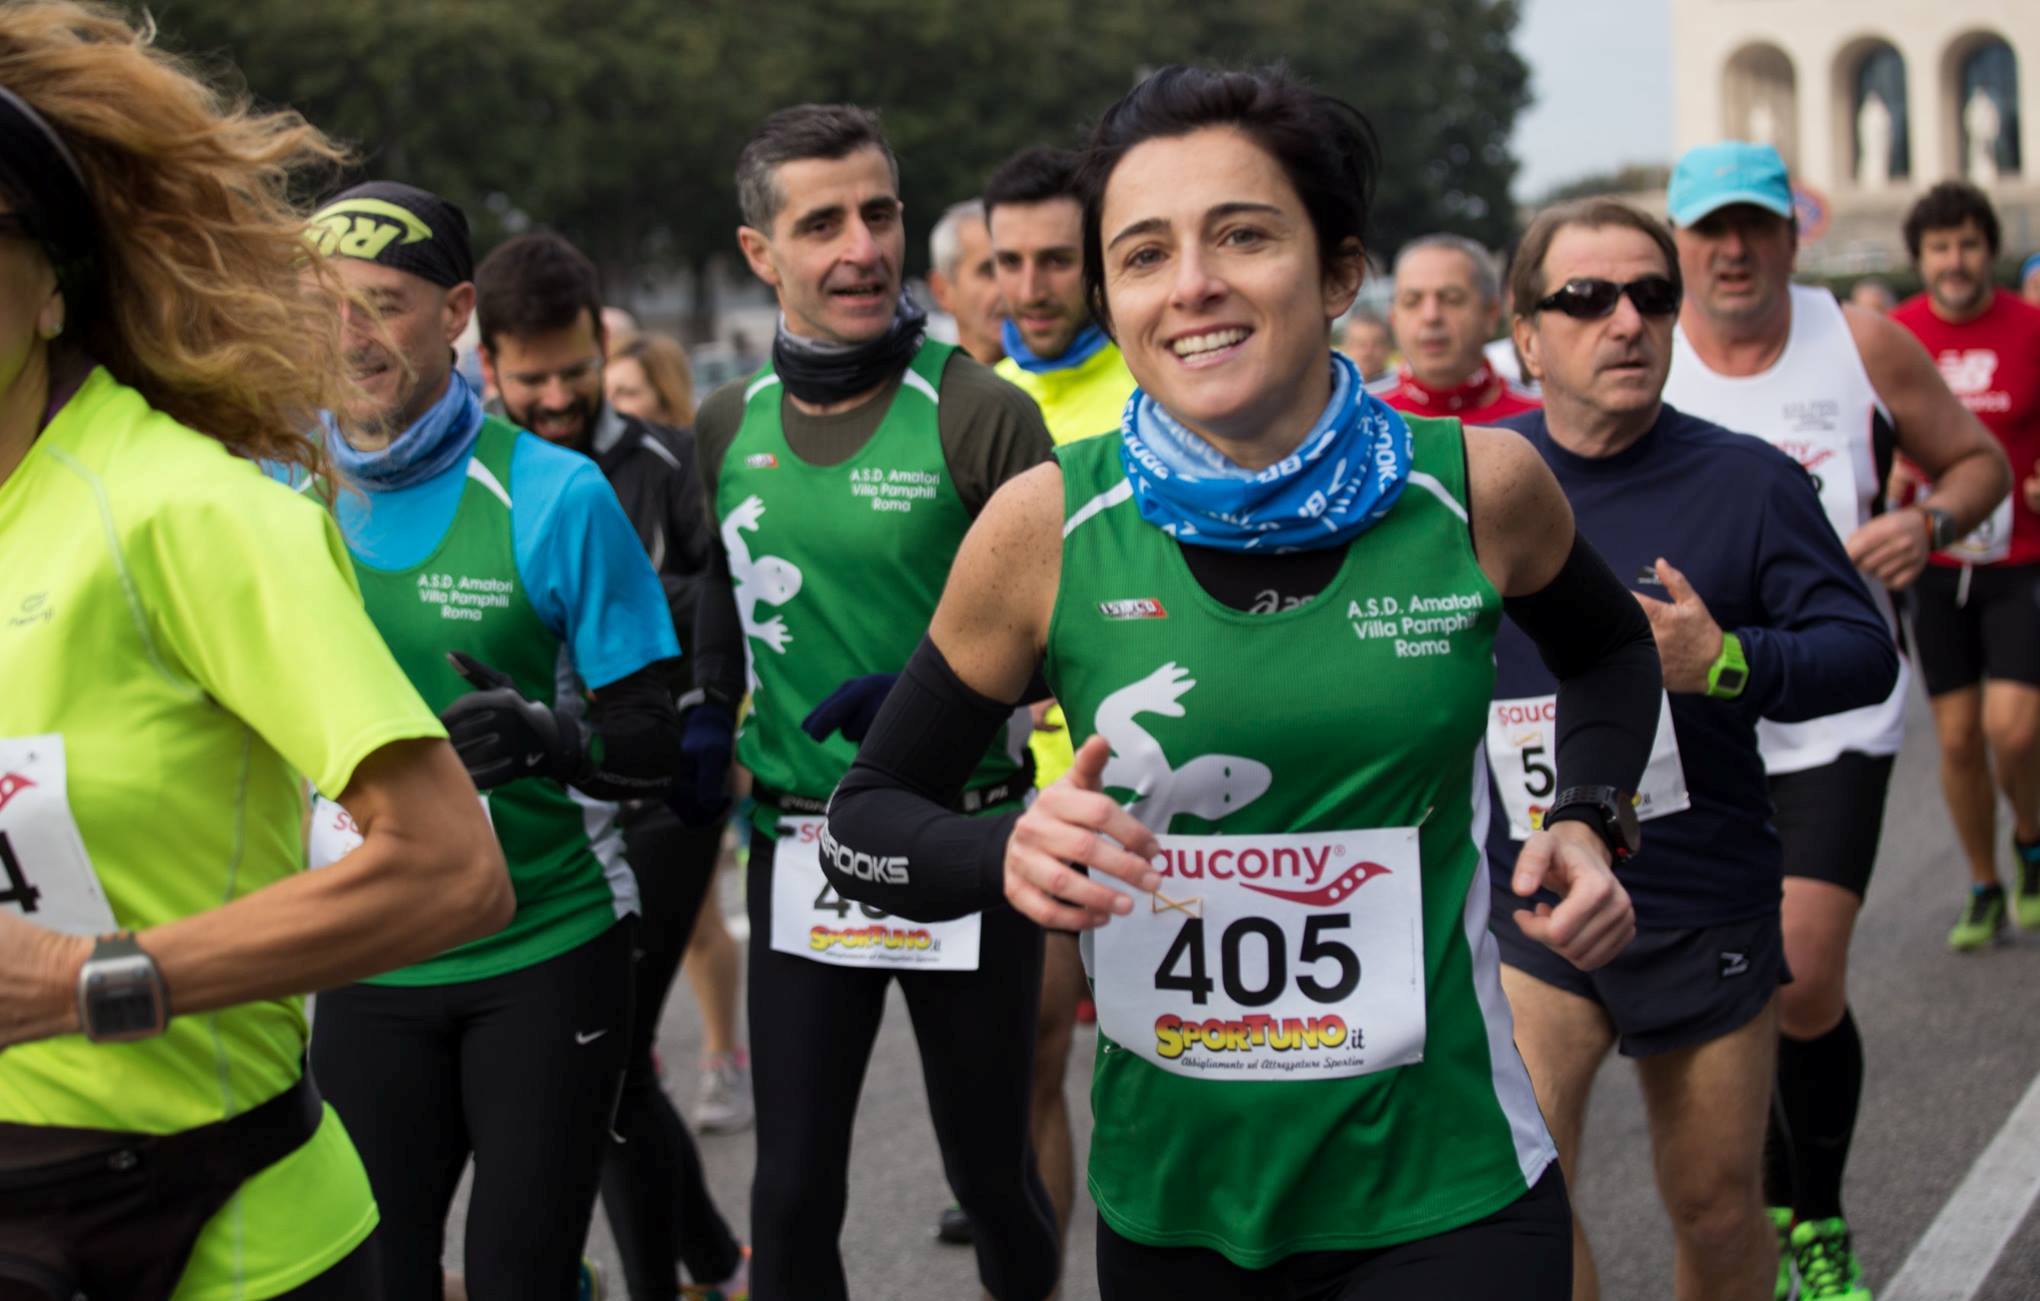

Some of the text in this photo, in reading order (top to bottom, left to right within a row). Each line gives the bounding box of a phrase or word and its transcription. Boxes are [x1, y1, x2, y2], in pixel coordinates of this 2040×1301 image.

[888, 470, 940, 485] Amatori
[851, 484, 878, 496] Villa
[872, 498, 911, 512] Roma
[459, 576, 513, 593] Amatori
[419, 588, 448, 603] Villa
[441, 604, 482, 621] Roma
[1347, 592, 1483, 618] A.S.D. Amatori
[1353, 619, 1398, 640] Villa
[1394, 639, 1451, 658] Roma
[1150, 845, 1331, 885] aucony
[814, 880, 893, 919] 4
[1154, 912, 1362, 1007] 405
